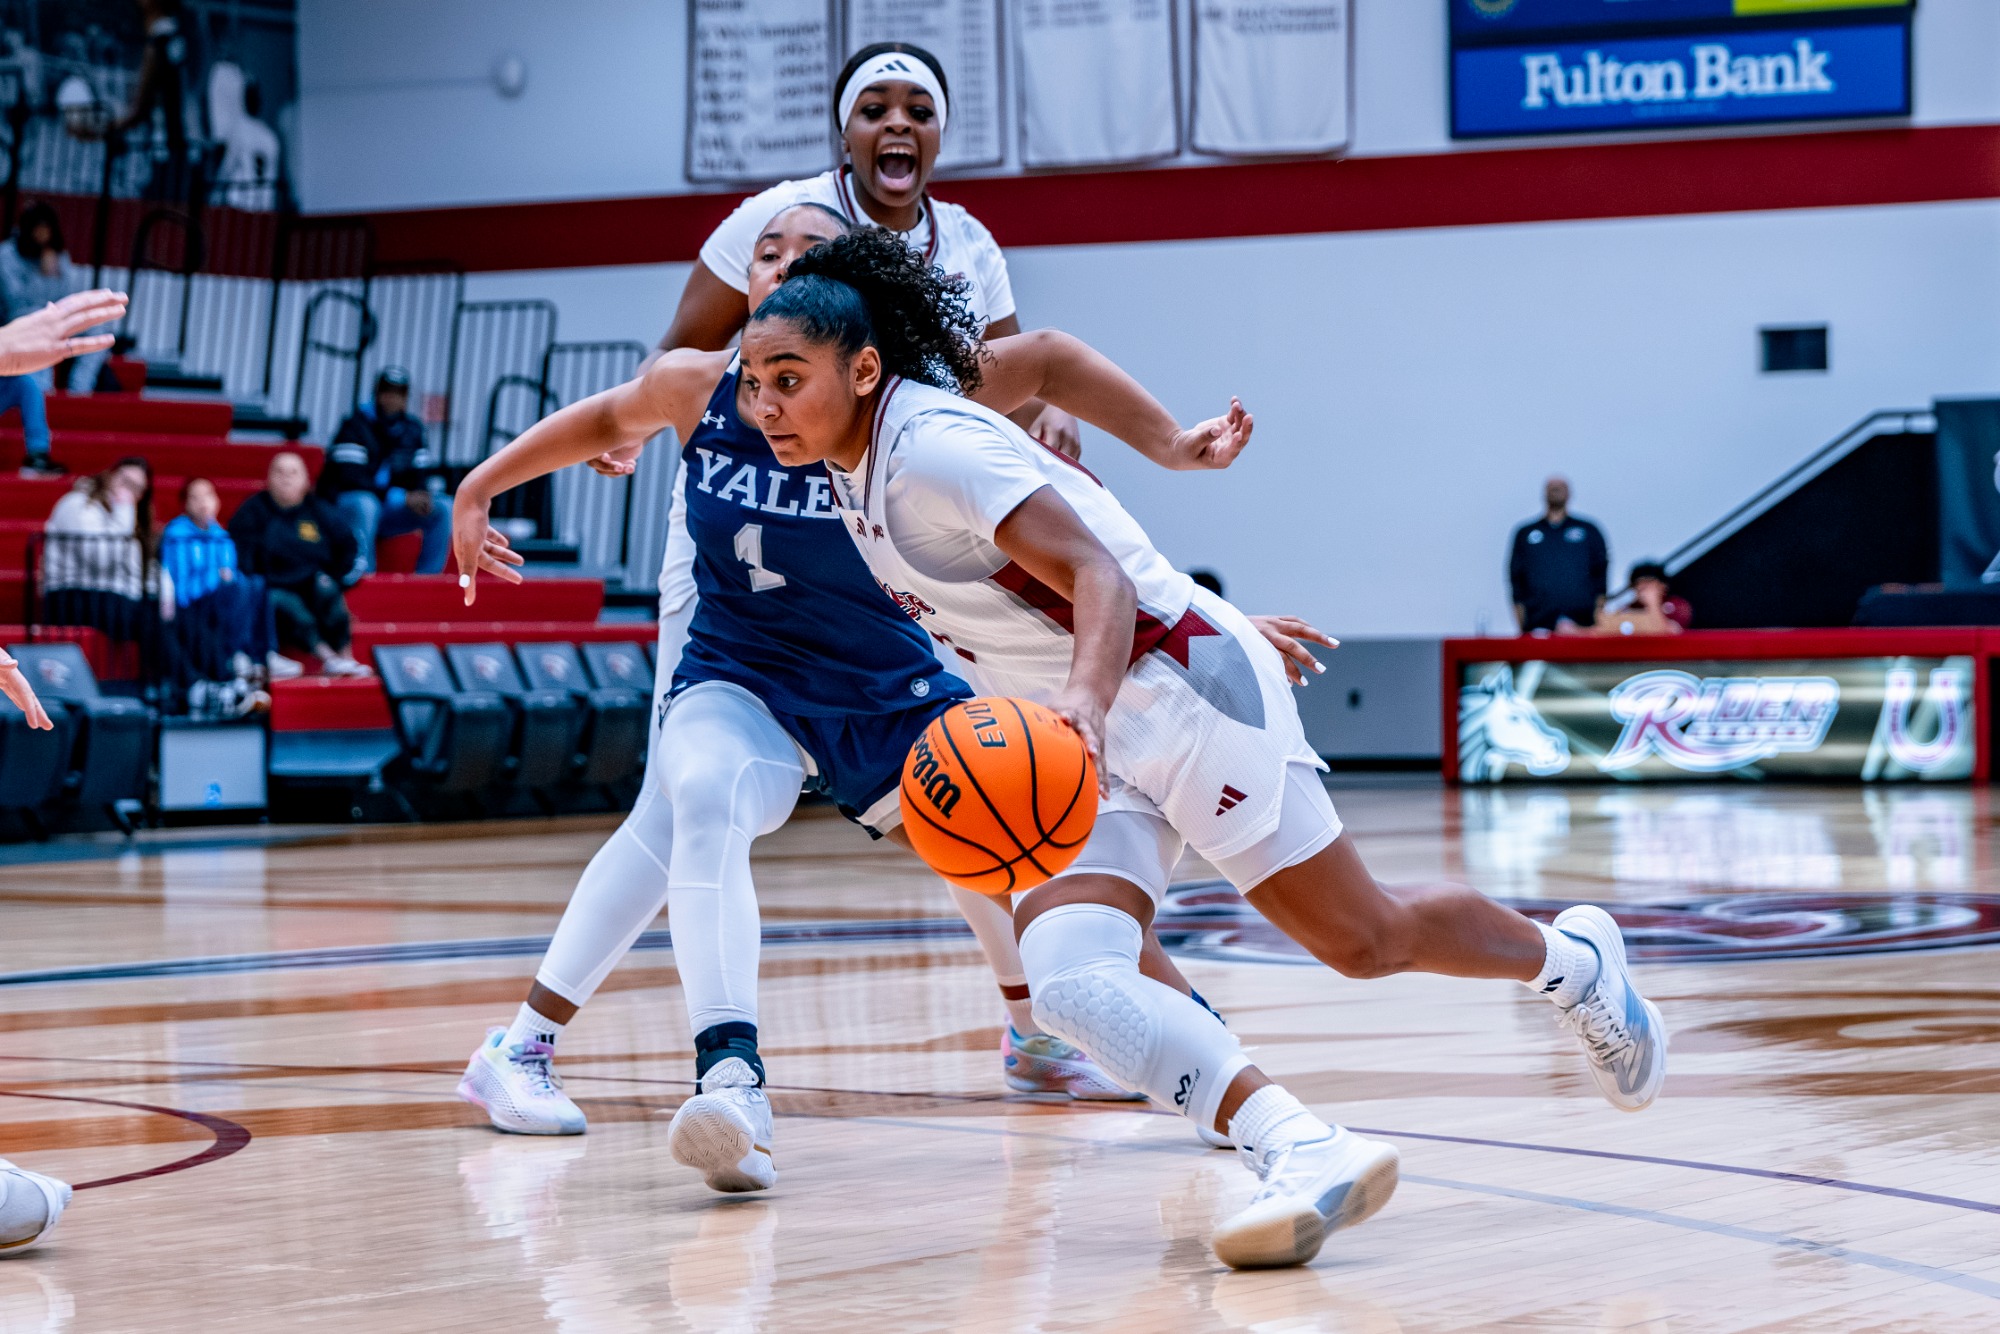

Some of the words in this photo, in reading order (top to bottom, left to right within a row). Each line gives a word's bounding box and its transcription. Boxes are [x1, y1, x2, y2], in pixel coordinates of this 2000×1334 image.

[1522, 50, 1687, 108] Fulton
[1690, 39, 1834, 98] Bank
[696, 447, 841, 520] YALE
[734, 522, 787, 593] 1
